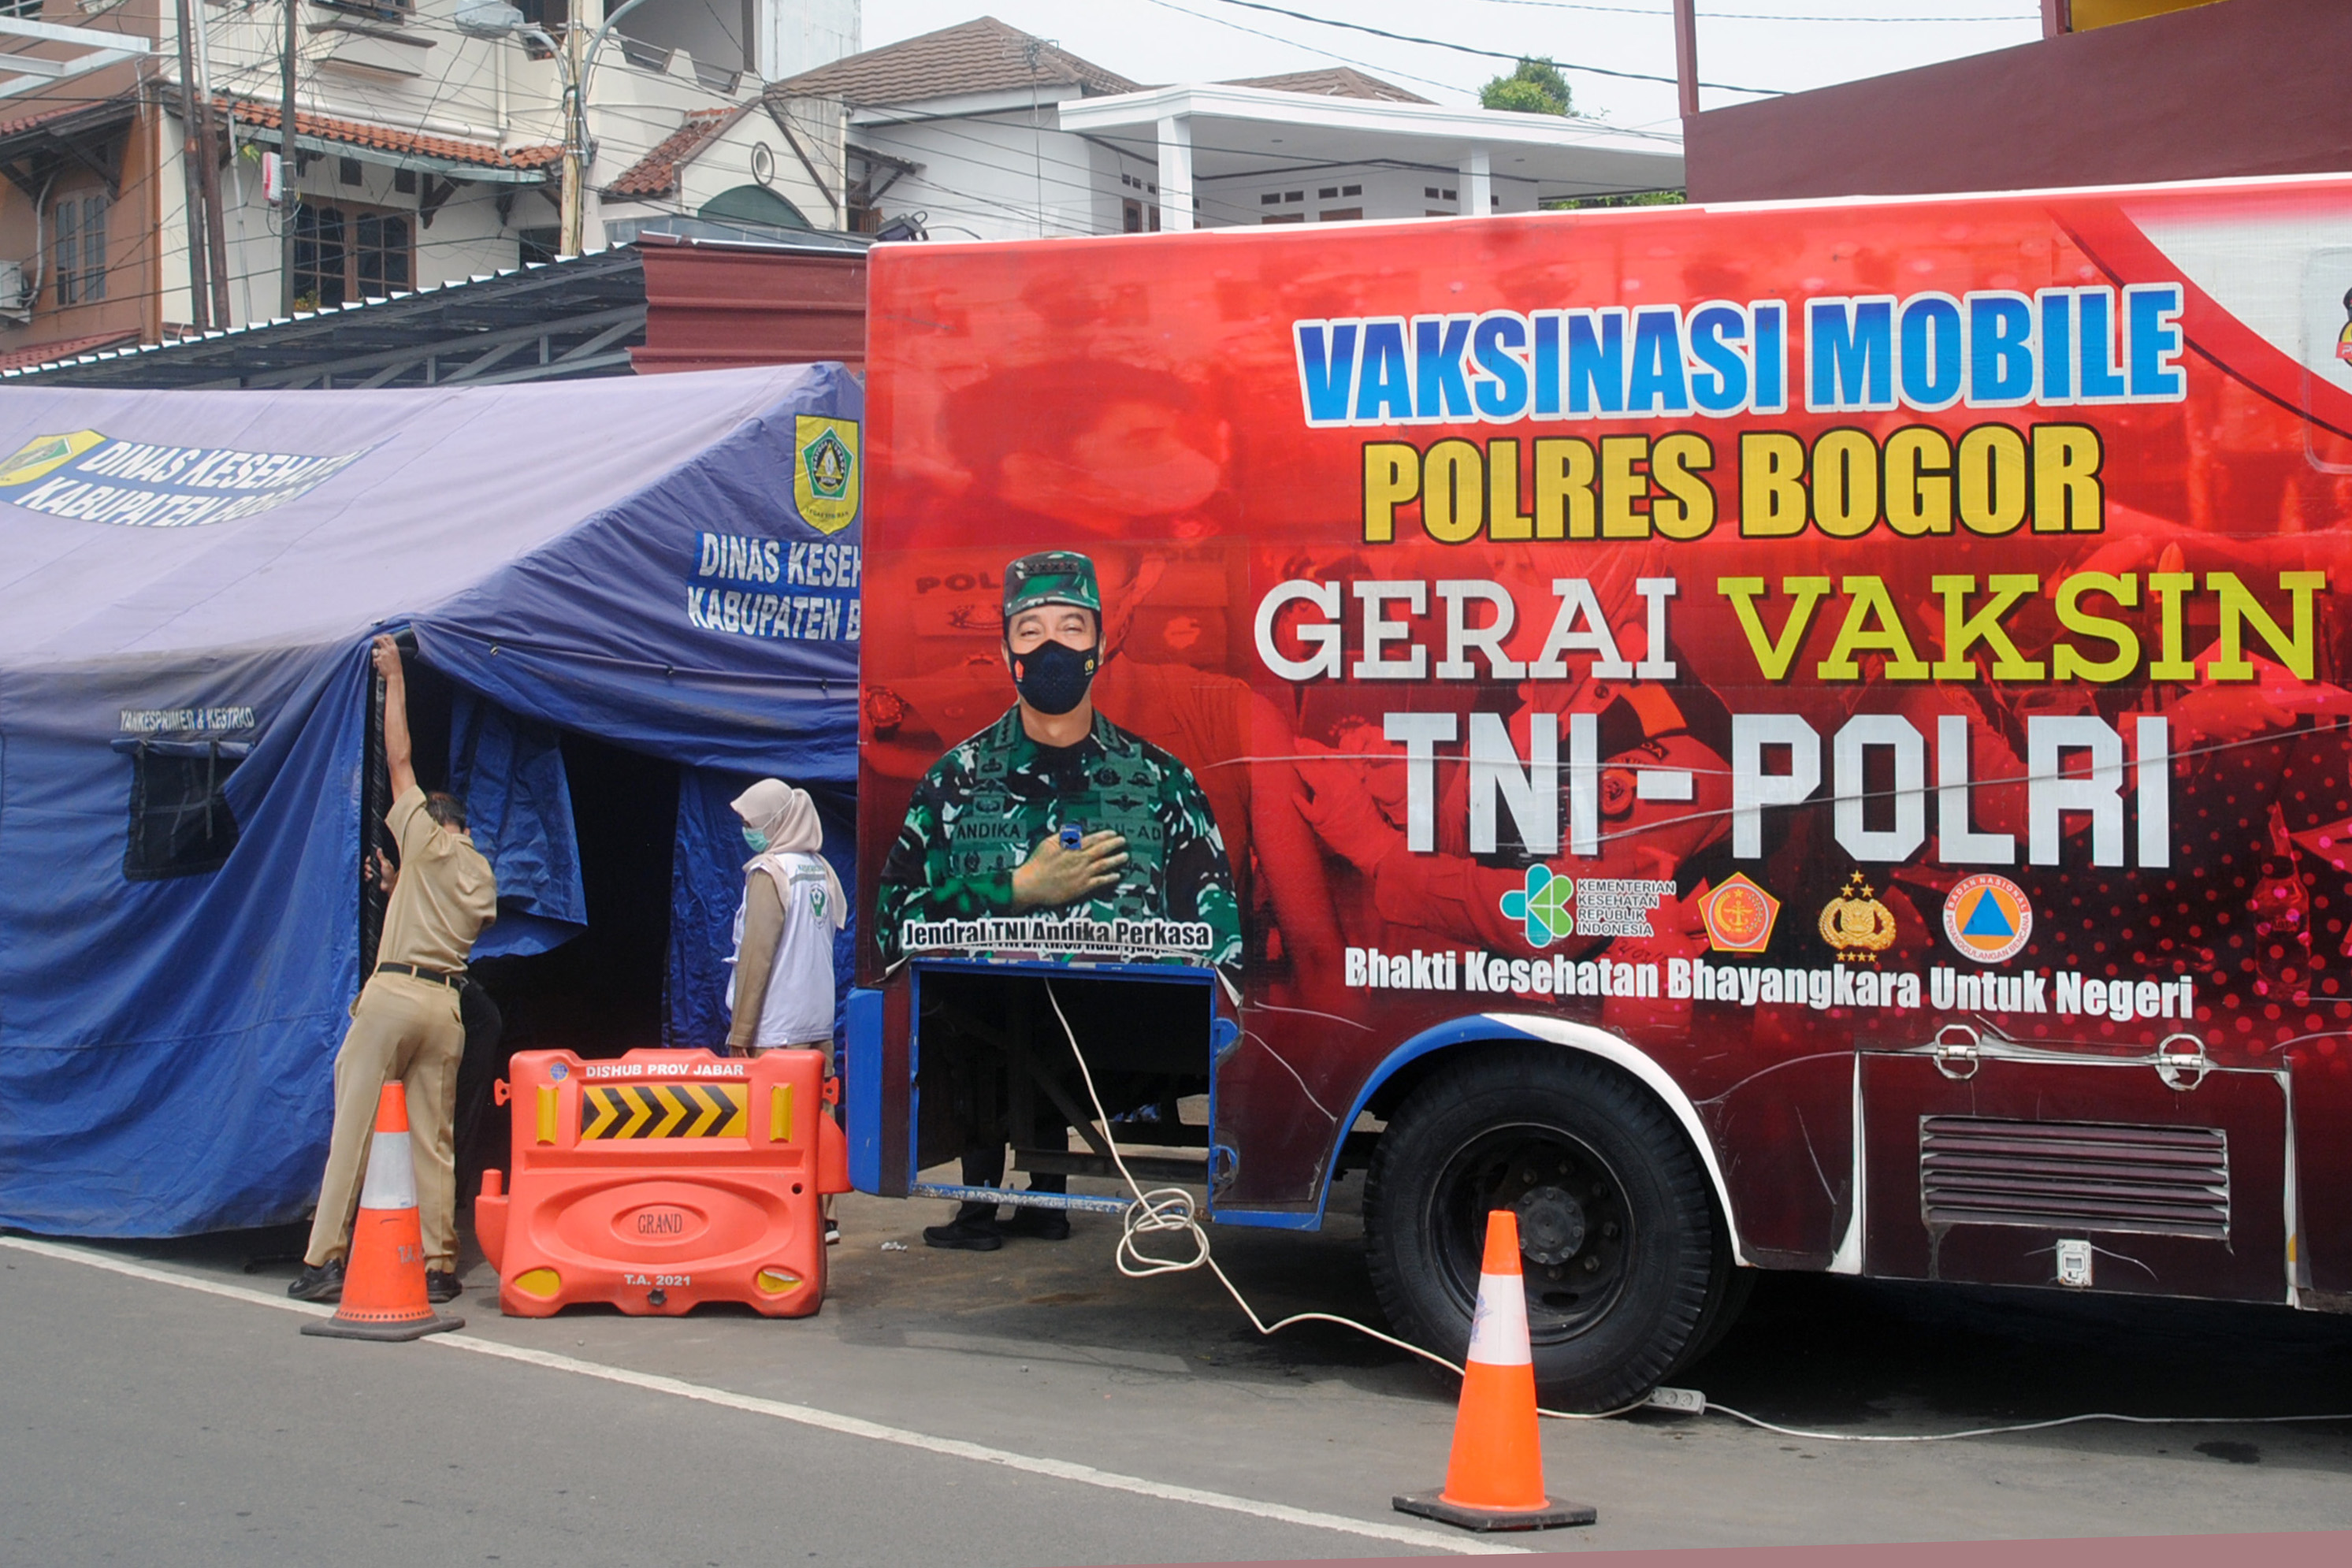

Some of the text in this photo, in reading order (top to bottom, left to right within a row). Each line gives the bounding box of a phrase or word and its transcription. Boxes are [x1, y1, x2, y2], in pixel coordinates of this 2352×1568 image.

[1293, 282, 2187, 427] VAKSINASI MOBILE
[76, 441, 197, 481] DINAS
[1362, 422, 2105, 544] POLRES BOGOR
[13, 476, 232, 527] KABUPATEN
[699, 533, 780, 583] DINAS
[688, 586, 841, 641] KABUPATEN
[1254, 570, 2326, 682] GERAI VAKSIN
[1384, 712, 1598, 856] TNI
[1732, 713, 2170, 868] POLRI
[957, 822, 1021, 839] ANDIKA
[1577, 880, 1675, 894] KEMENTERIAN
[1577, 894, 1658, 908] KESEHATAN
[1947, 876, 2027, 911] BADAN NASIONAL
[1577, 908, 1646, 921] REPUBLIK
[1577, 923, 1653, 936] INDONESIA
[904, 920, 1210, 947] Jendral TNI Andika Perkasa
[2008, 914, 2031, 952] BENCANA
[1345, 947, 1457, 990] Bhakti
[1466, 951, 1659, 998] Kesehatan
[1666, 957, 1920, 1010] Bhayangkara
[1930, 966, 2047, 1013] Untuk
[2056, 970, 2194, 1022] Negeri
[585, 1064, 745, 1078] DISHUB PROV JABAR
[637, 1213, 682, 1234] GRAND
[624, 1273, 691, 1287] T.A. 2021
